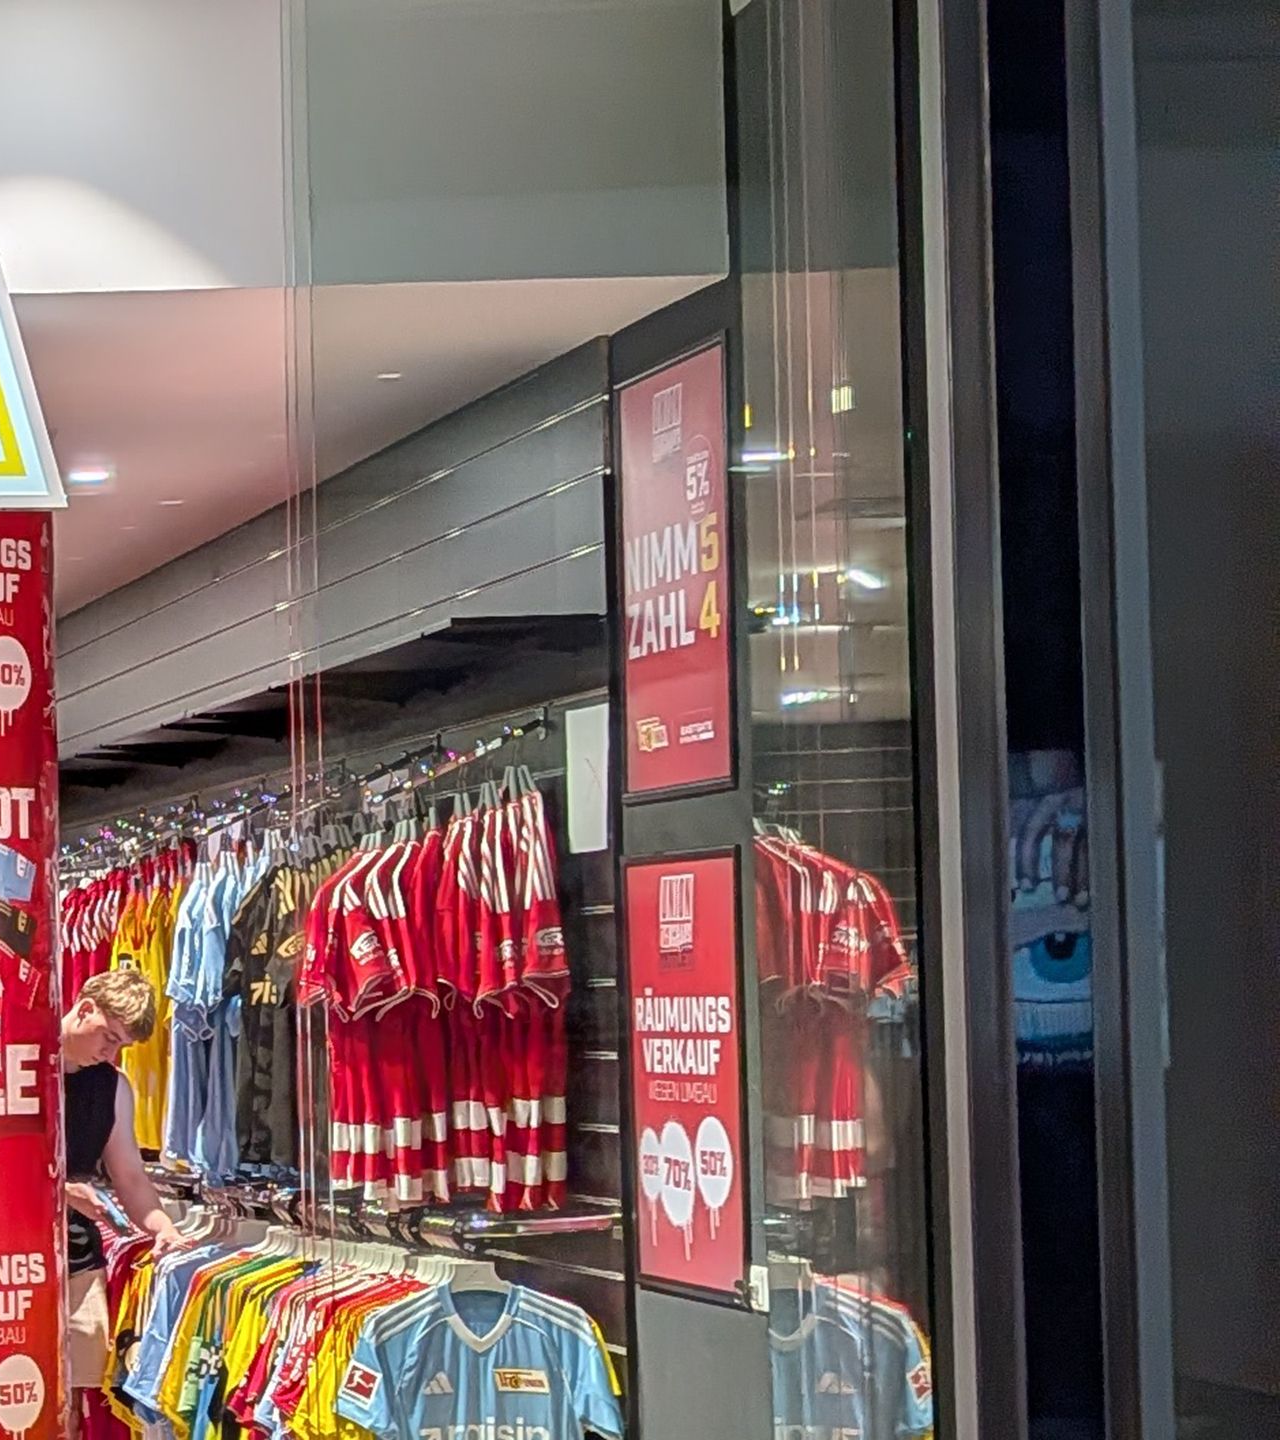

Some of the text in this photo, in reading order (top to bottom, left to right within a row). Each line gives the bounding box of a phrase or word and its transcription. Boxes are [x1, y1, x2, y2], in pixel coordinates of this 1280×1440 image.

[686, 460, 711, 501] 5%
[625, 511, 720, 598] NIMM 5
[626, 579, 721, 660] ZAHL 4
[635, 987, 732, 1034] RÄUMUNGS
[641, 1037, 722, 1077] VERKAUF
[663, 1157, 692, 1192] 70%
[699, 1150, 728, 1178] 50%
